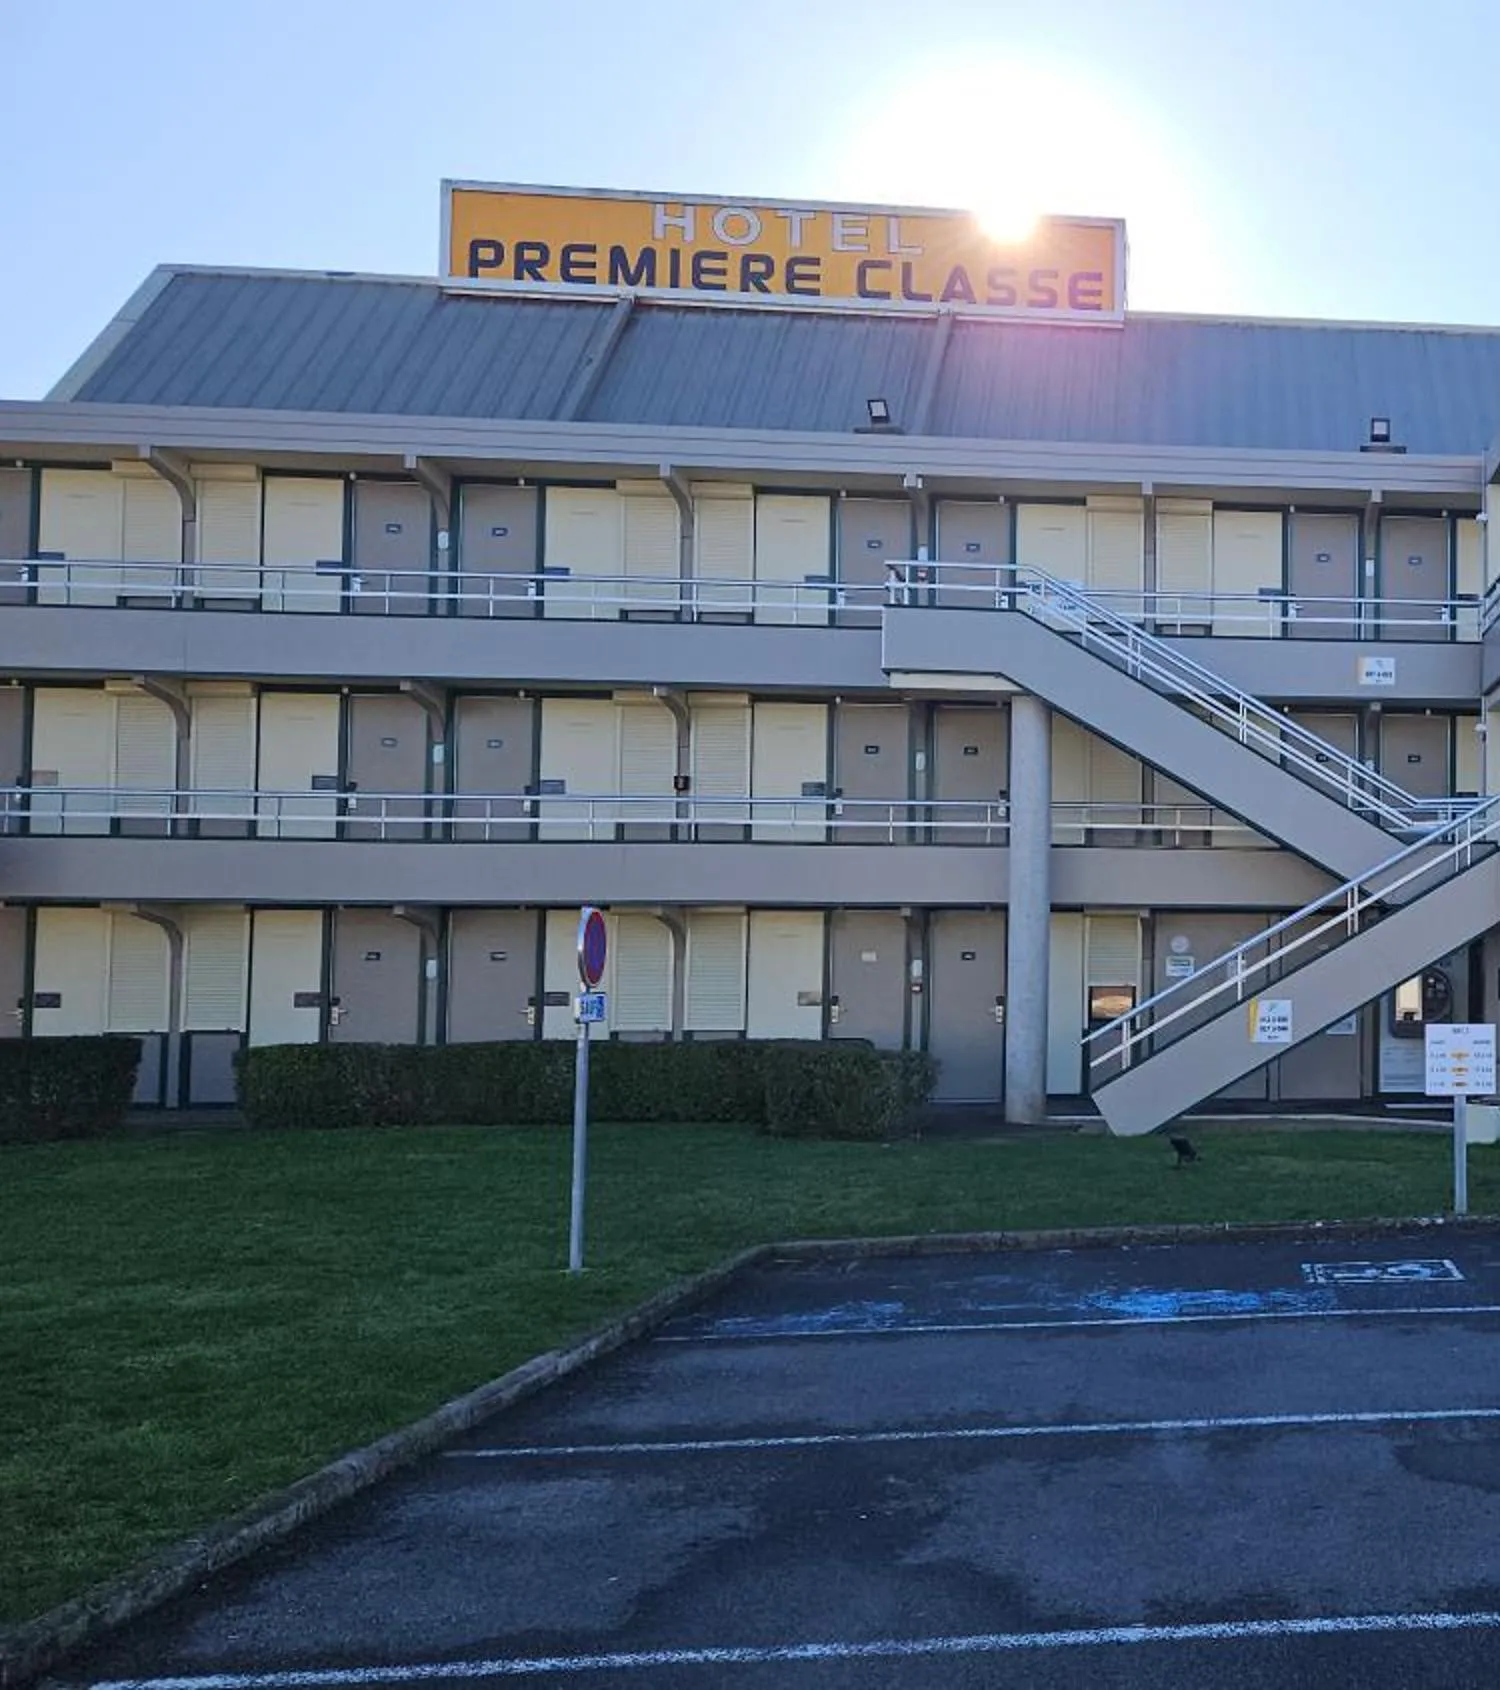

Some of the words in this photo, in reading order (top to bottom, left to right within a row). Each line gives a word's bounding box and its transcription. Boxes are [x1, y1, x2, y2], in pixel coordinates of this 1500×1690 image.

[652, 203, 924, 255] HOTEL
[468, 239, 821, 295] PREMIERE
[856, 259, 1103, 311] CLASSE
